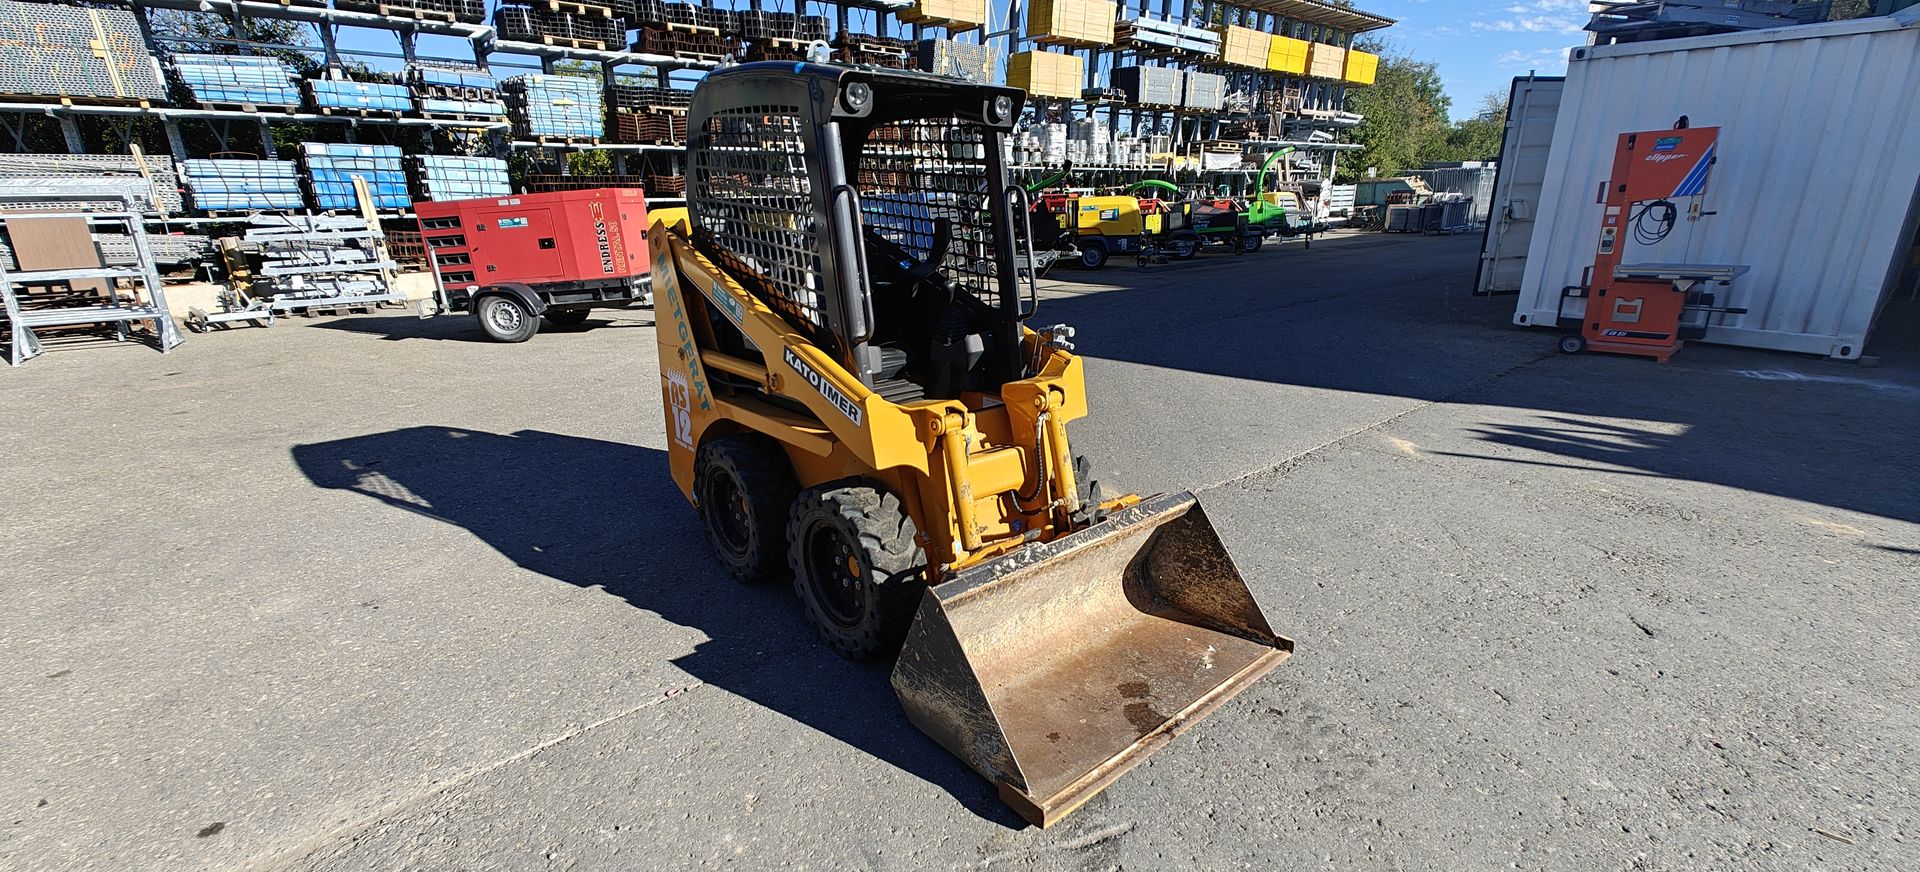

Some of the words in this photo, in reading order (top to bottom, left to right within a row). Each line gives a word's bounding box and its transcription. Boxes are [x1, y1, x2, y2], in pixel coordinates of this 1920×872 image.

[1645, 153, 1684, 163] clipper
[594, 221, 614, 274] ENDRESS
[671, 381, 687, 409] RS
[785, 349, 819, 386] KATO
[823, 381, 859, 422] IMER
[672, 405, 693, 446] 12
